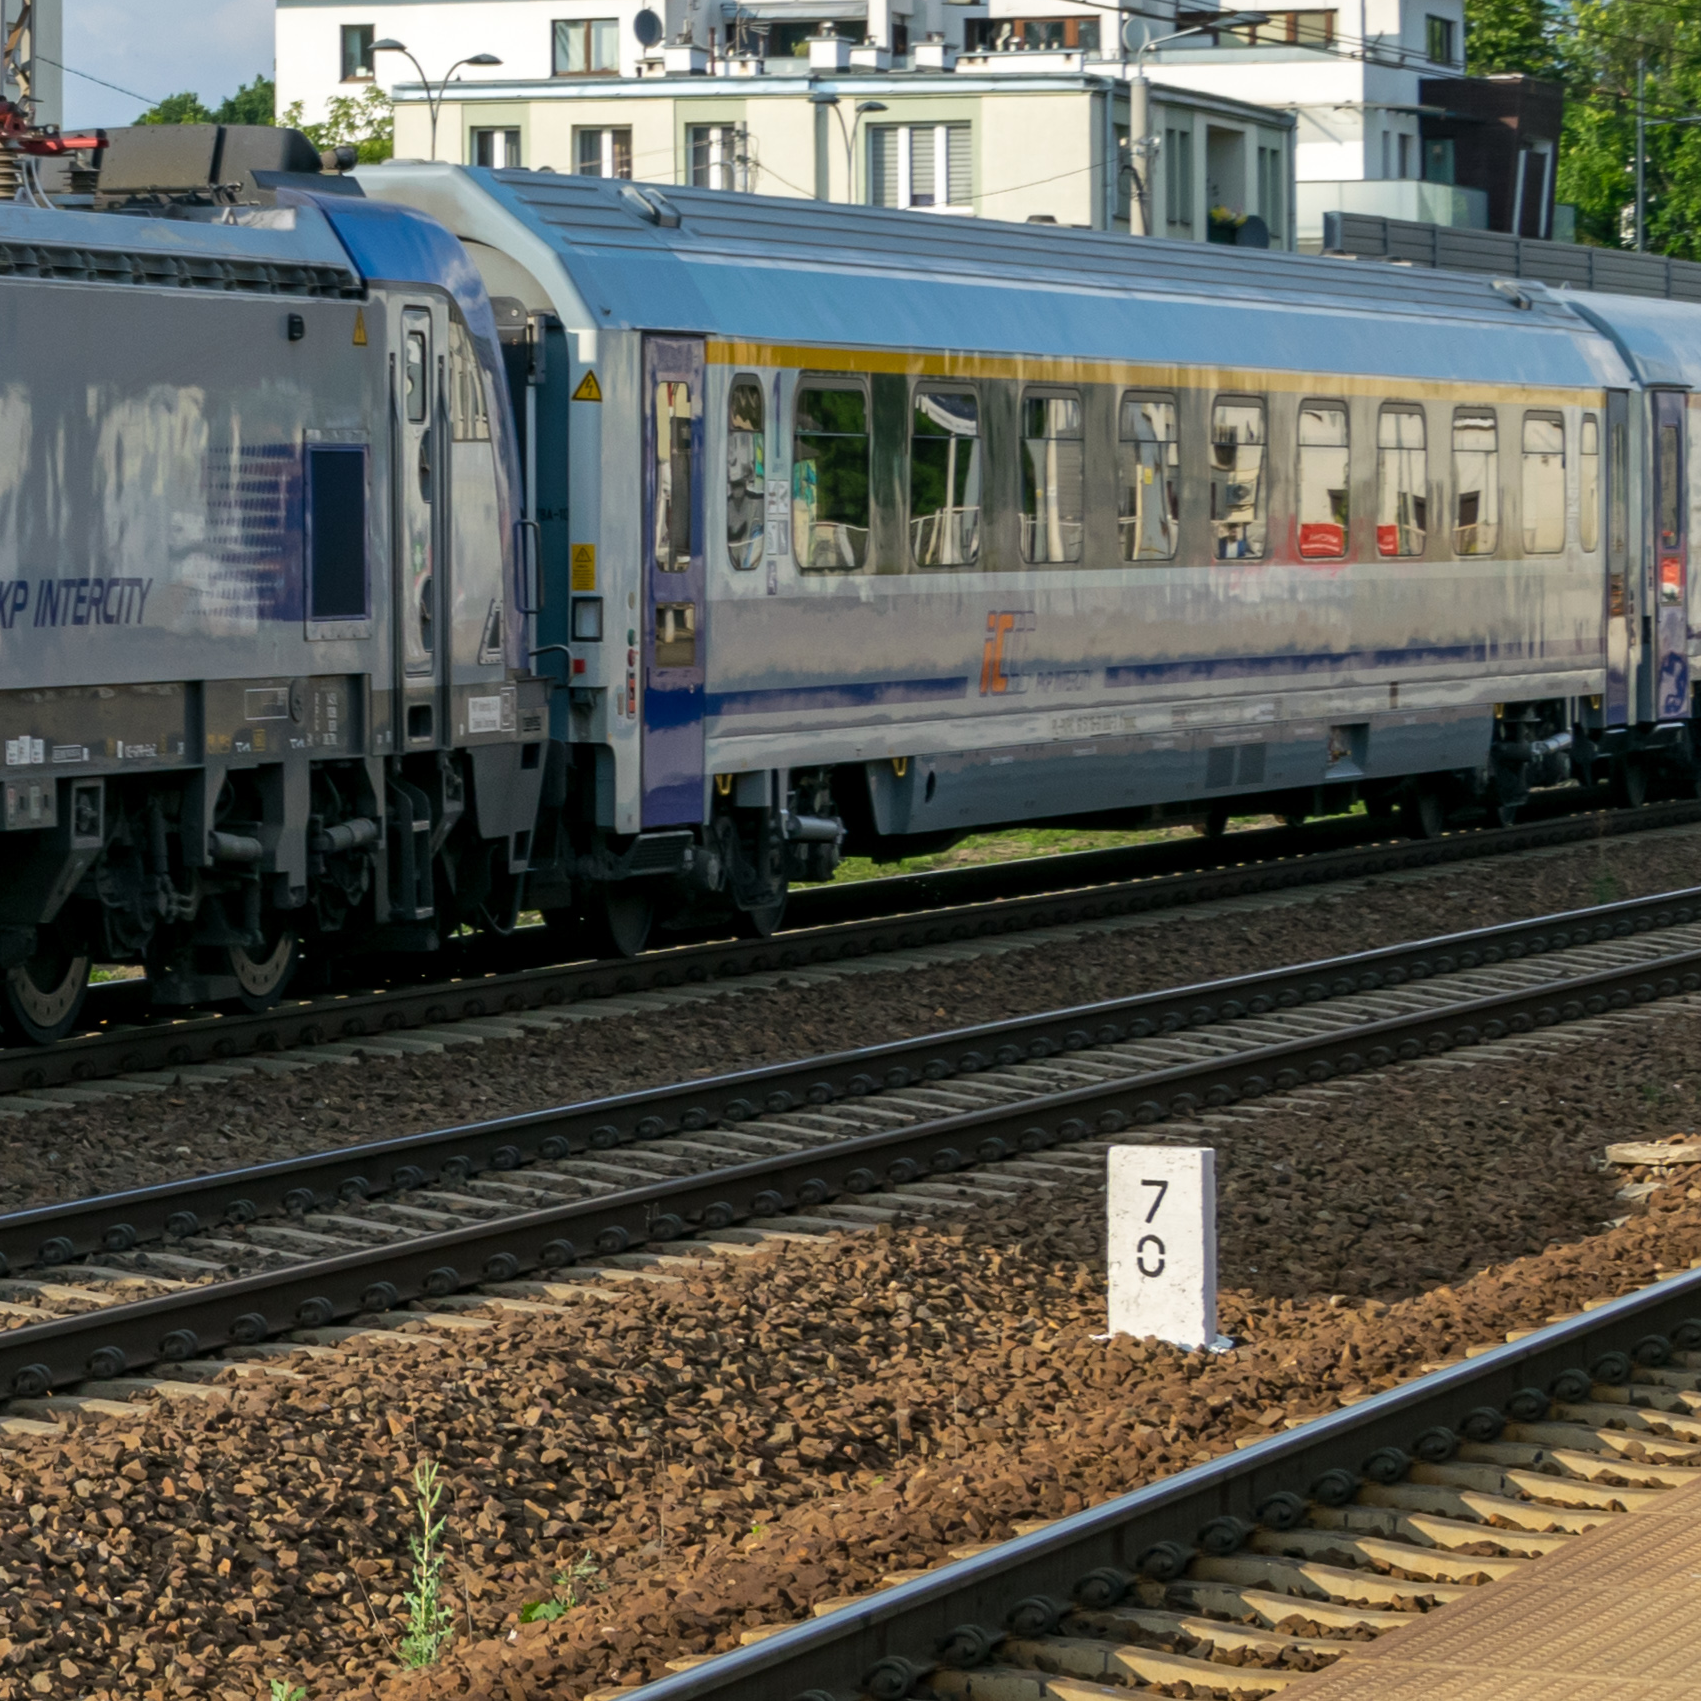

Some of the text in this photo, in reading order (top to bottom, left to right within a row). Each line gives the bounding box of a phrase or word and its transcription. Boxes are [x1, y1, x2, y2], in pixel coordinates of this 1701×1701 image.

[33, 577, 153, 628] INTERCITY
[1141, 1179, 1168, 1224] 7
[1137, 1234, 1165, 1278] 0
